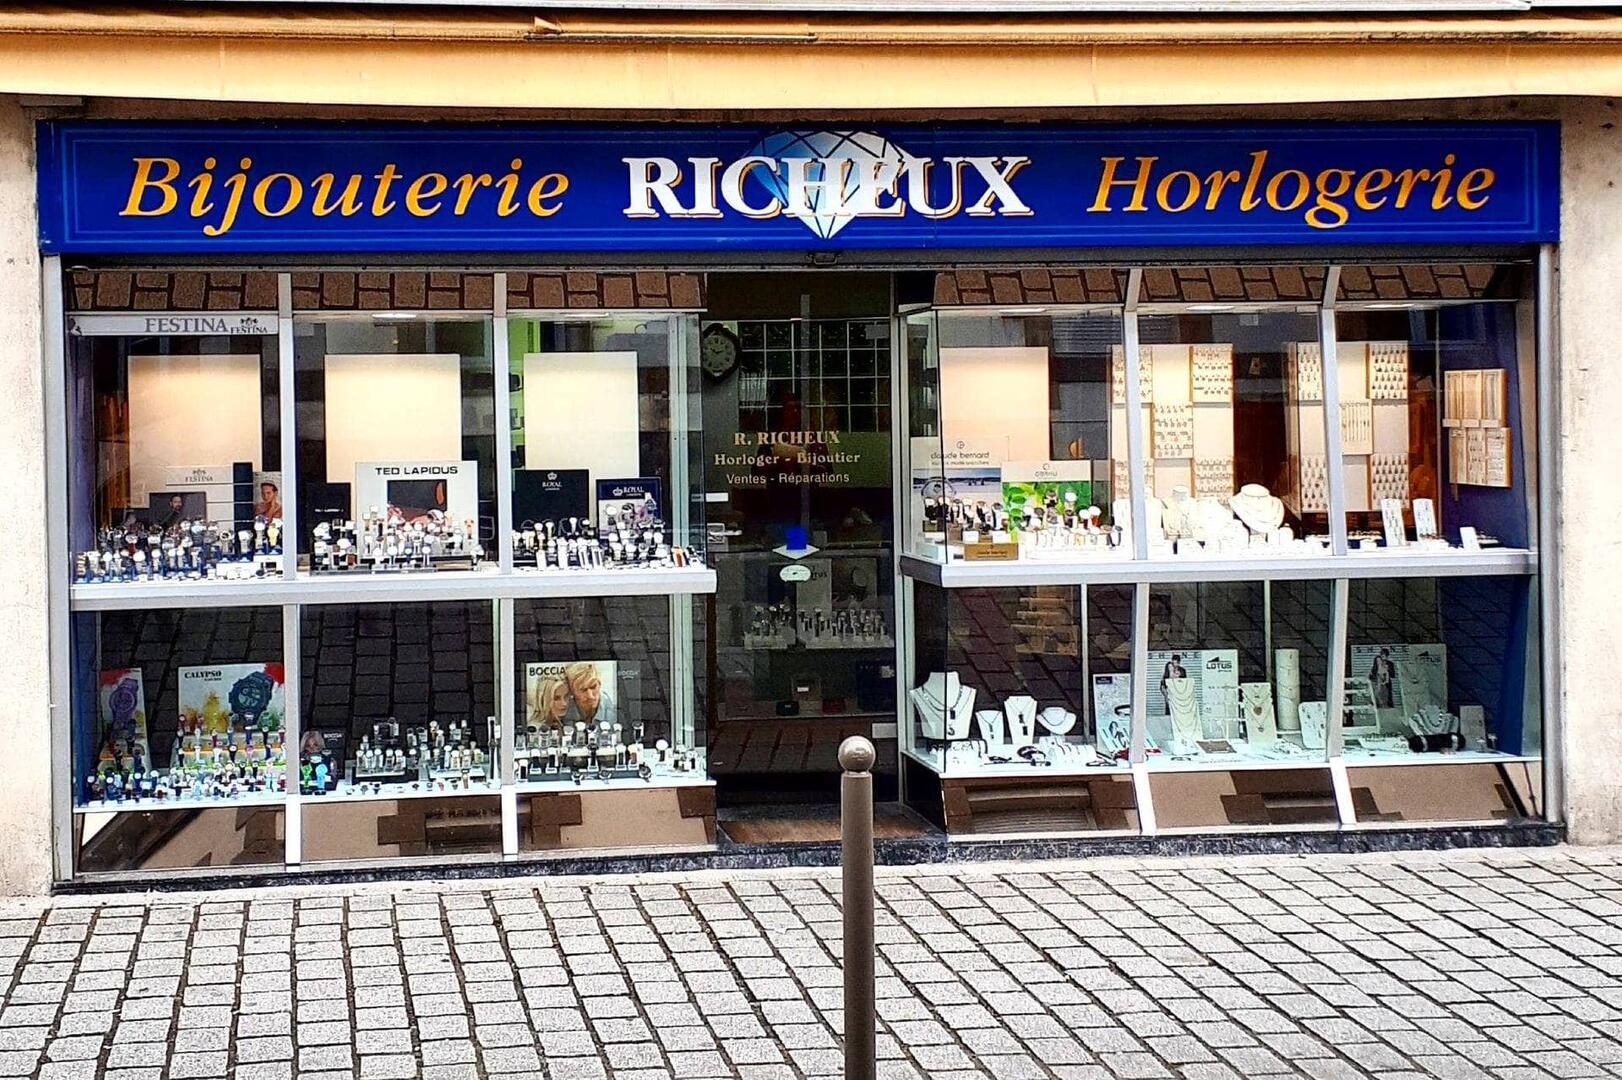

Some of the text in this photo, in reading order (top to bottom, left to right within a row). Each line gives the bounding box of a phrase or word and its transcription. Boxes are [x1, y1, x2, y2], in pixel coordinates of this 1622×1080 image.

[119, 150, 1496, 236] Bijouterie RICHEUX Horlogerie
[144, 317, 228, 333] FESTINA
[230, 326, 268, 334] FESTINA
[734, 430, 841, 446] R. RICHEUX
[714, 453, 779, 467] Horloger
[797, 452, 861, 466] Bijoutier
[375, 466, 458, 475] TED LAPIDUS
[726, 474, 767, 485] Ventes
[779, 473, 850, 486] Réparations
[1206, 661, 1232, 669] LOTUS
[184, 670, 222, 679] CALYPSO
[529, 666, 566, 677] BOCCIA
